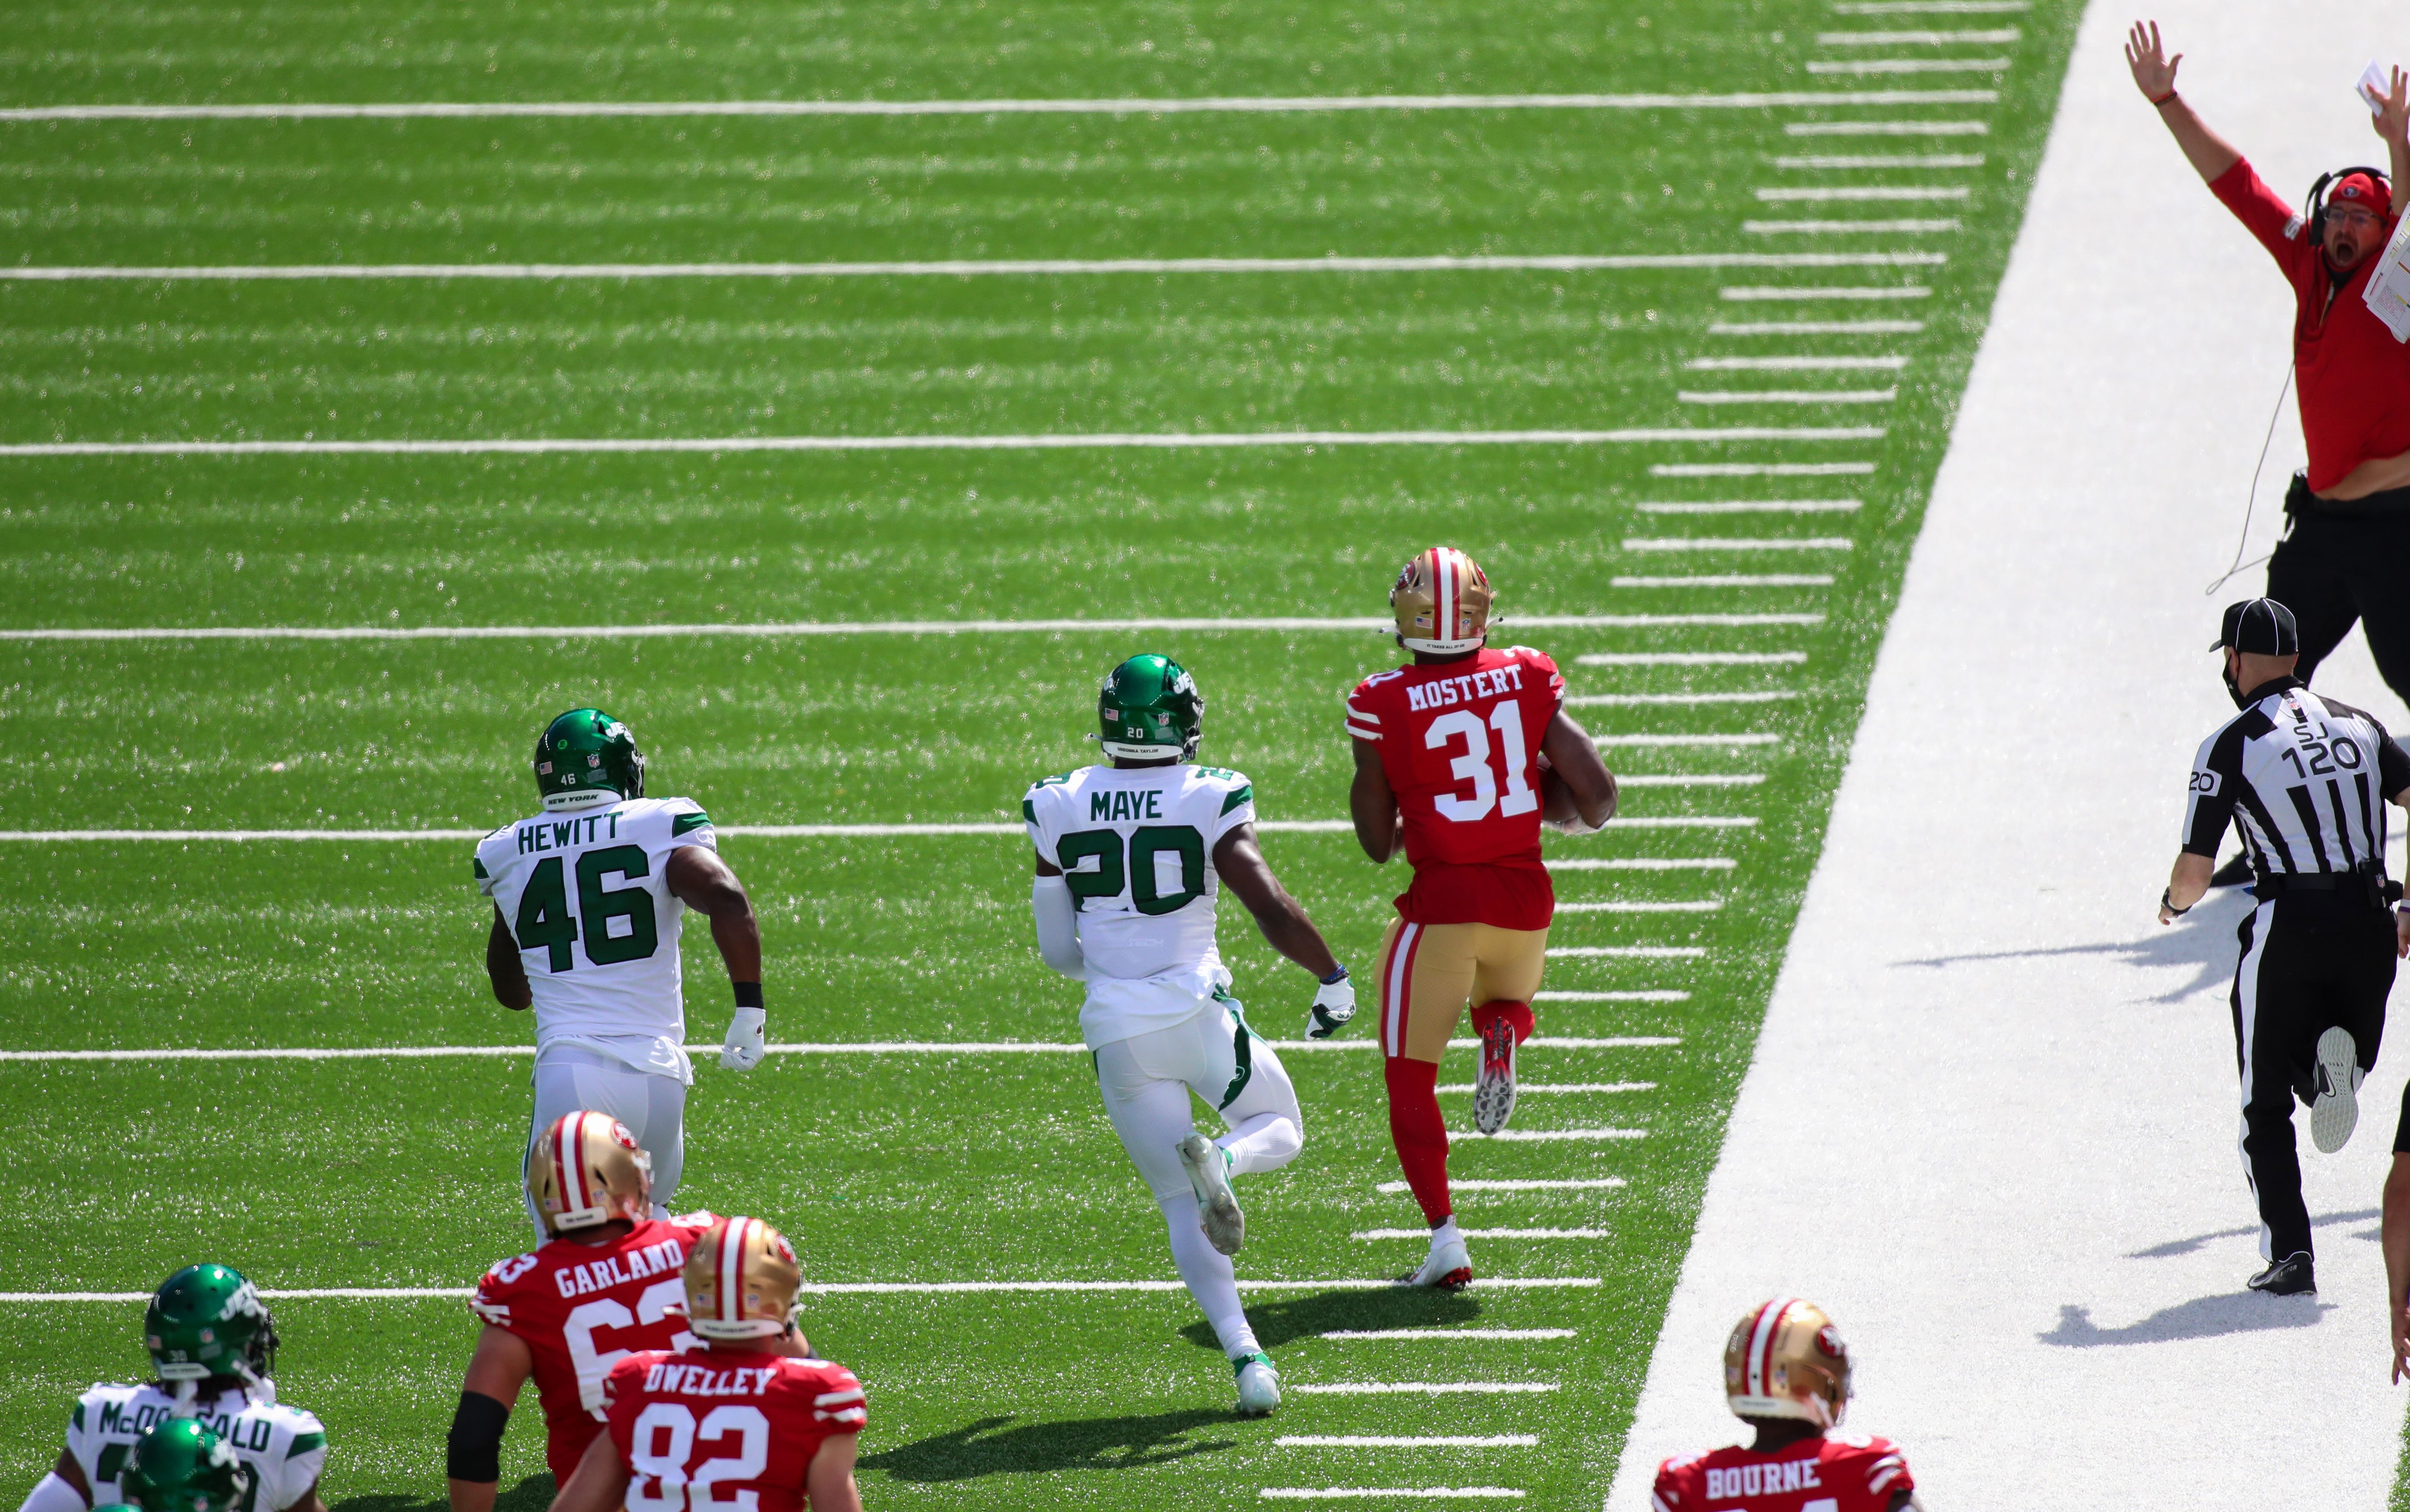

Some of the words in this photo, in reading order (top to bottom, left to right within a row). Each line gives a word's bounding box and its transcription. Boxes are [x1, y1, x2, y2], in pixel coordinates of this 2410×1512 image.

[1406, 664, 1523, 712] MOSTERT
[1128, 727, 1143, 738] 20
[2293, 722, 2329, 743] SJ
[561, 773, 576, 785] 46
[1425, 699, 1538, 822] 31
[2281, 737, 2361, 779] 120
[568, 794, 598, 802] YORK
[1091, 790, 1163, 821] MAYE
[518, 811, 623, 855] HEWITT
[1056, 825, 1206, 916] 20
[515, 844, 659, 973] 46
[554, 1238, 684, 1298] GARLAND
[643, 1363, 778, 1397] DWELLEY
[624, 1402, 770, 1512] 82
[1705, 1457, 1822, 1501] BOURNE
